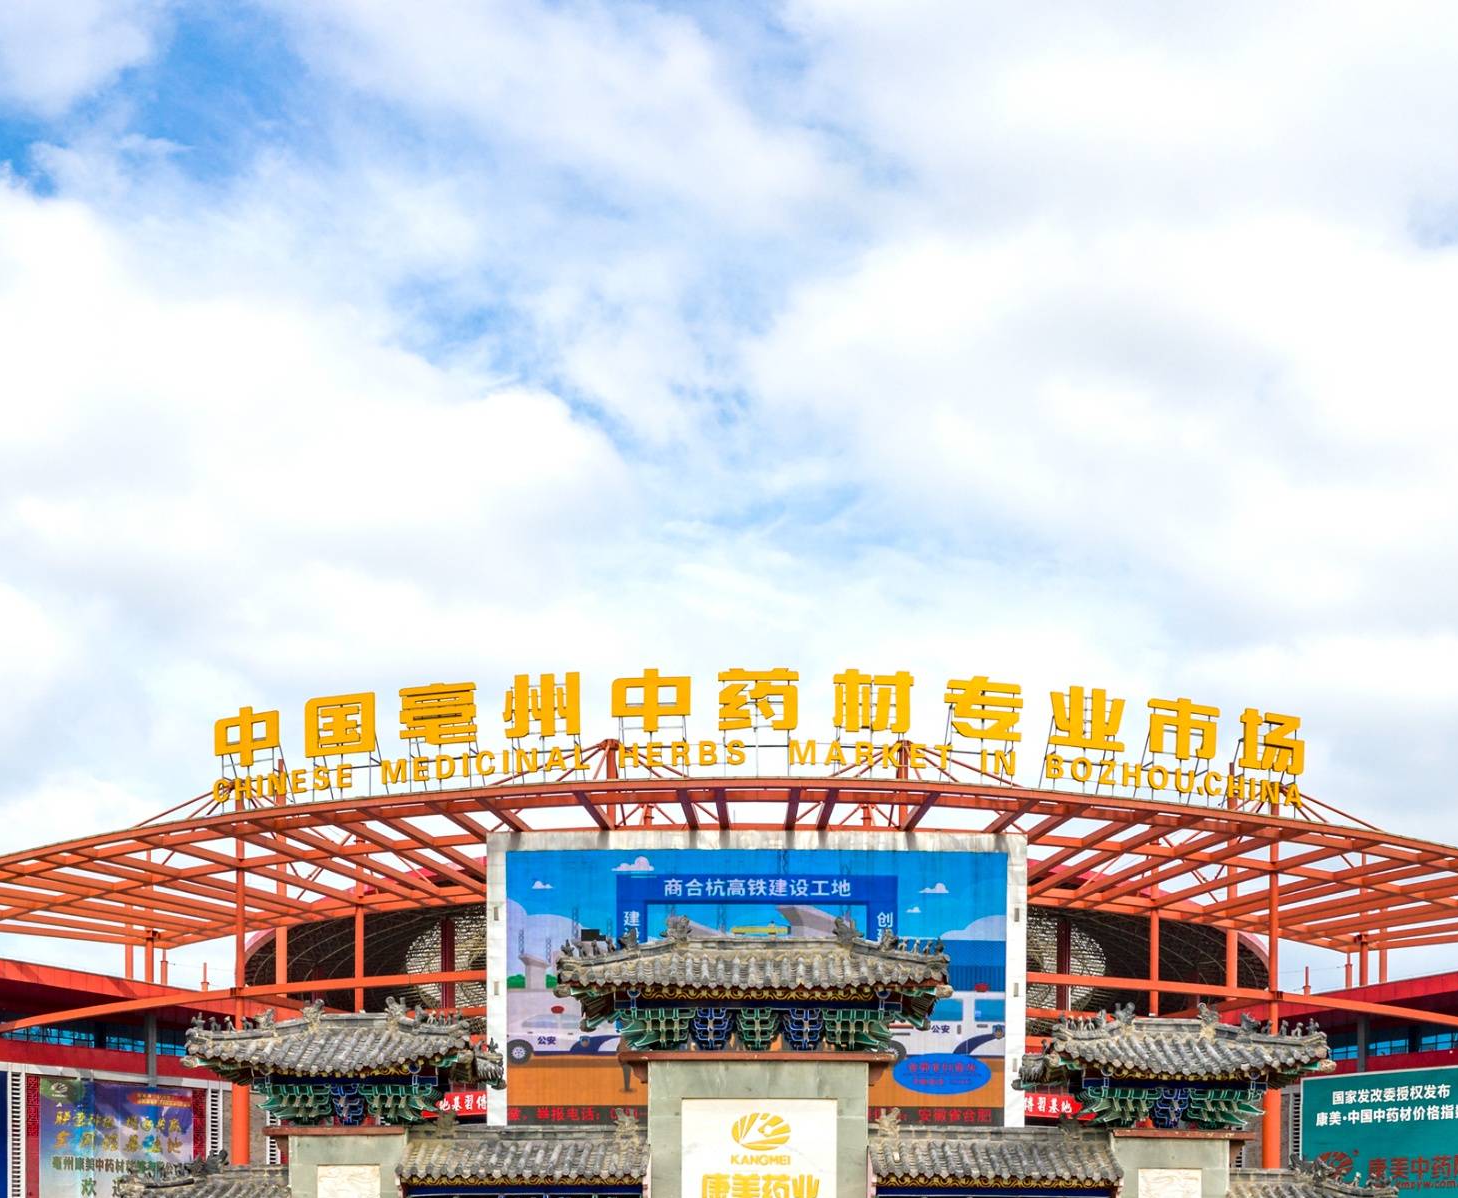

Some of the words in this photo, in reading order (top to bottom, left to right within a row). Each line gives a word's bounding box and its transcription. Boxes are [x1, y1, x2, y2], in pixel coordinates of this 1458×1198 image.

[214, 668, 1305, 775] 中国亳州中药材专业市场
[212, 762, 354, 803] CHINESE
[381, 747, 591, 786] MEDICINAL
[618, 739, 748, 769] HERBS
[789, 738, 953, 770] MARKET
[980, 748, 1017, 777] IN
[664, 878, 851, 897] 商合杭高铁建设工地
[931, 1024, 950, 1034] 公安
[537, 1036, 556, 1045] 公安
[1332, 1084, 1451, 1105] 国家发改委授权发布
[730, 1155, 791, 1166] KANGMEI
